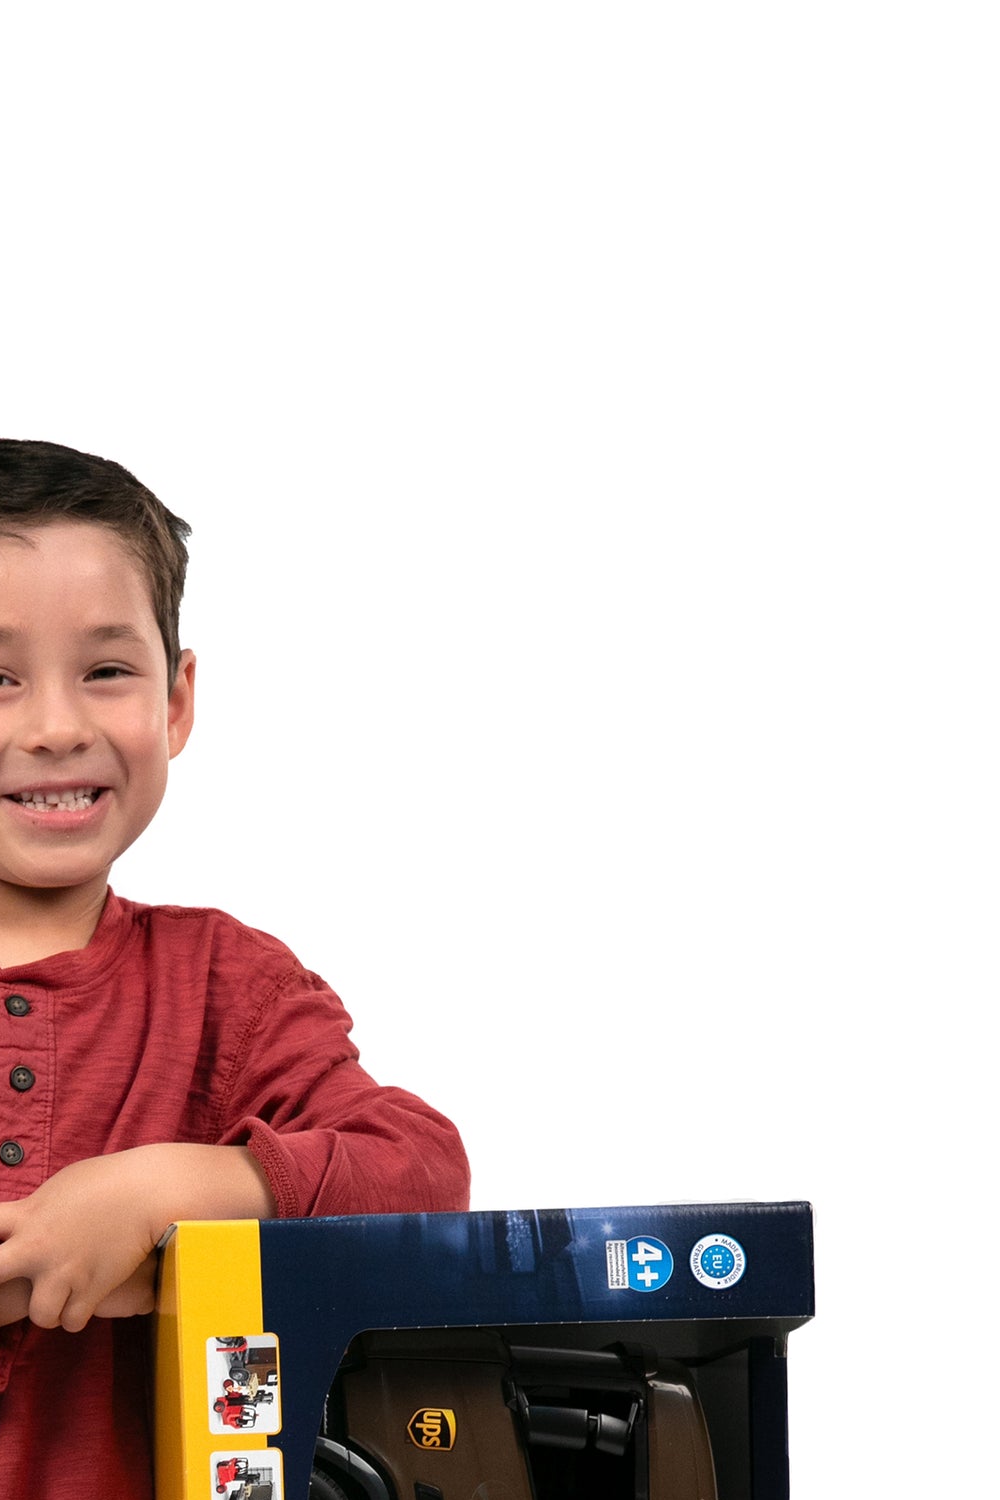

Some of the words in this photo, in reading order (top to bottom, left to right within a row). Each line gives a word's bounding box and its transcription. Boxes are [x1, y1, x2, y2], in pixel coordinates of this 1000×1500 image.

[721, 1238, 738, 1253] MADE
[632, 1241, 663, 1287] 4+
[693, 1244, 705, 1279] GERMANY
[712, 1254, 722, 1269] EU
[735, 1253, 742, 1262] BY
[723, 1263, 742, 1284] BRUDER
[415, 1411, 441, 1447] ups
